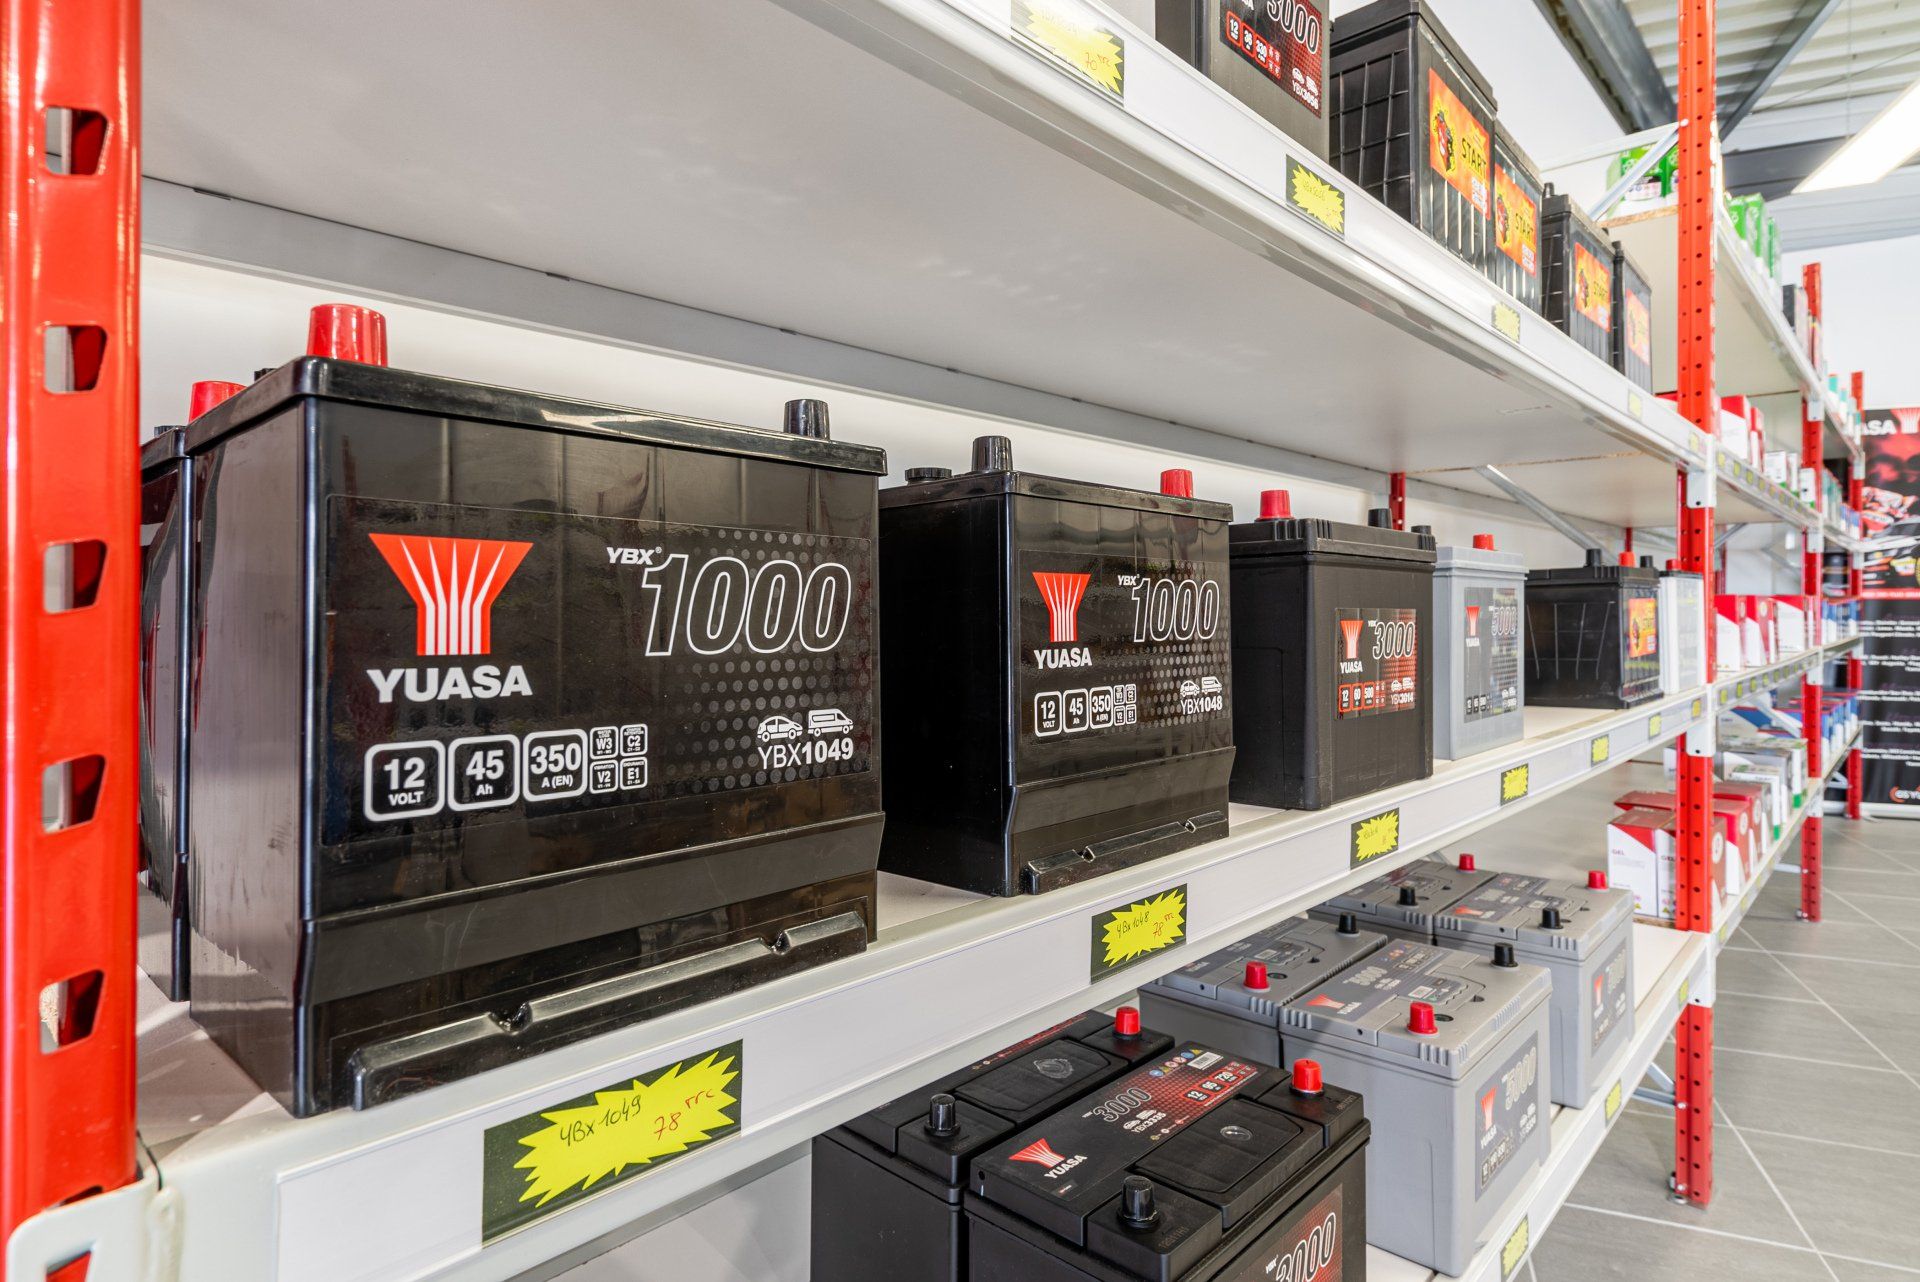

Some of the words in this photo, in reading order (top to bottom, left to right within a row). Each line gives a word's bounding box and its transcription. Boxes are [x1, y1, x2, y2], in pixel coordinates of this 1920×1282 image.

[1461, 138, 1487, 179] START
[1515, 212, 1534, 244] START
[641, 553, 852, 657] 1000
[1131, 577, 1220, 643] 1000
[1372, 621, 1415, 660] 3000
[1034, 648, 1093, 669] YUASA
[1340, 661, 1363, 674] YUASA
[367, 665, 533, 703] YUASA
[1040, 700, 1056, 720] 12
[1069, 697, 1083, 716] 45
[1092, 694, 1111, 713] 350
[1180, 695, 1223, 715] YBX1048
[1042, 720, 1055, 728] VOLT
[1072, 717, 1080, 725] Ah
[595, 737, 613, 750] W3
[627, 735, 641, 747] C2
[530, 743, 582, 775] 350
[758, 738, 853, 770] YBX1049
[383, 757, 425, 790] 12
[465, 749, 505, 781] 45
[627, 767, 640, 780] E1
[541, 777, 551, 789] A
[551, 775, 574, 788] (EN)
[597, 771, 611, 783] V2
[388, 790, 425, 807] VOLT
[475, 784, 493, 796] Ah
[1214, 1071, 1233, 1082] 720
[1093, 1088, 1152, 1122] 3000
[1187, 1090, 1203, 1100] 12
[597, 1095, 641, 1127] 1049
[653, 1112, 683, 1141] 78
[1043, 1154, 1088, 1180] YUASA
